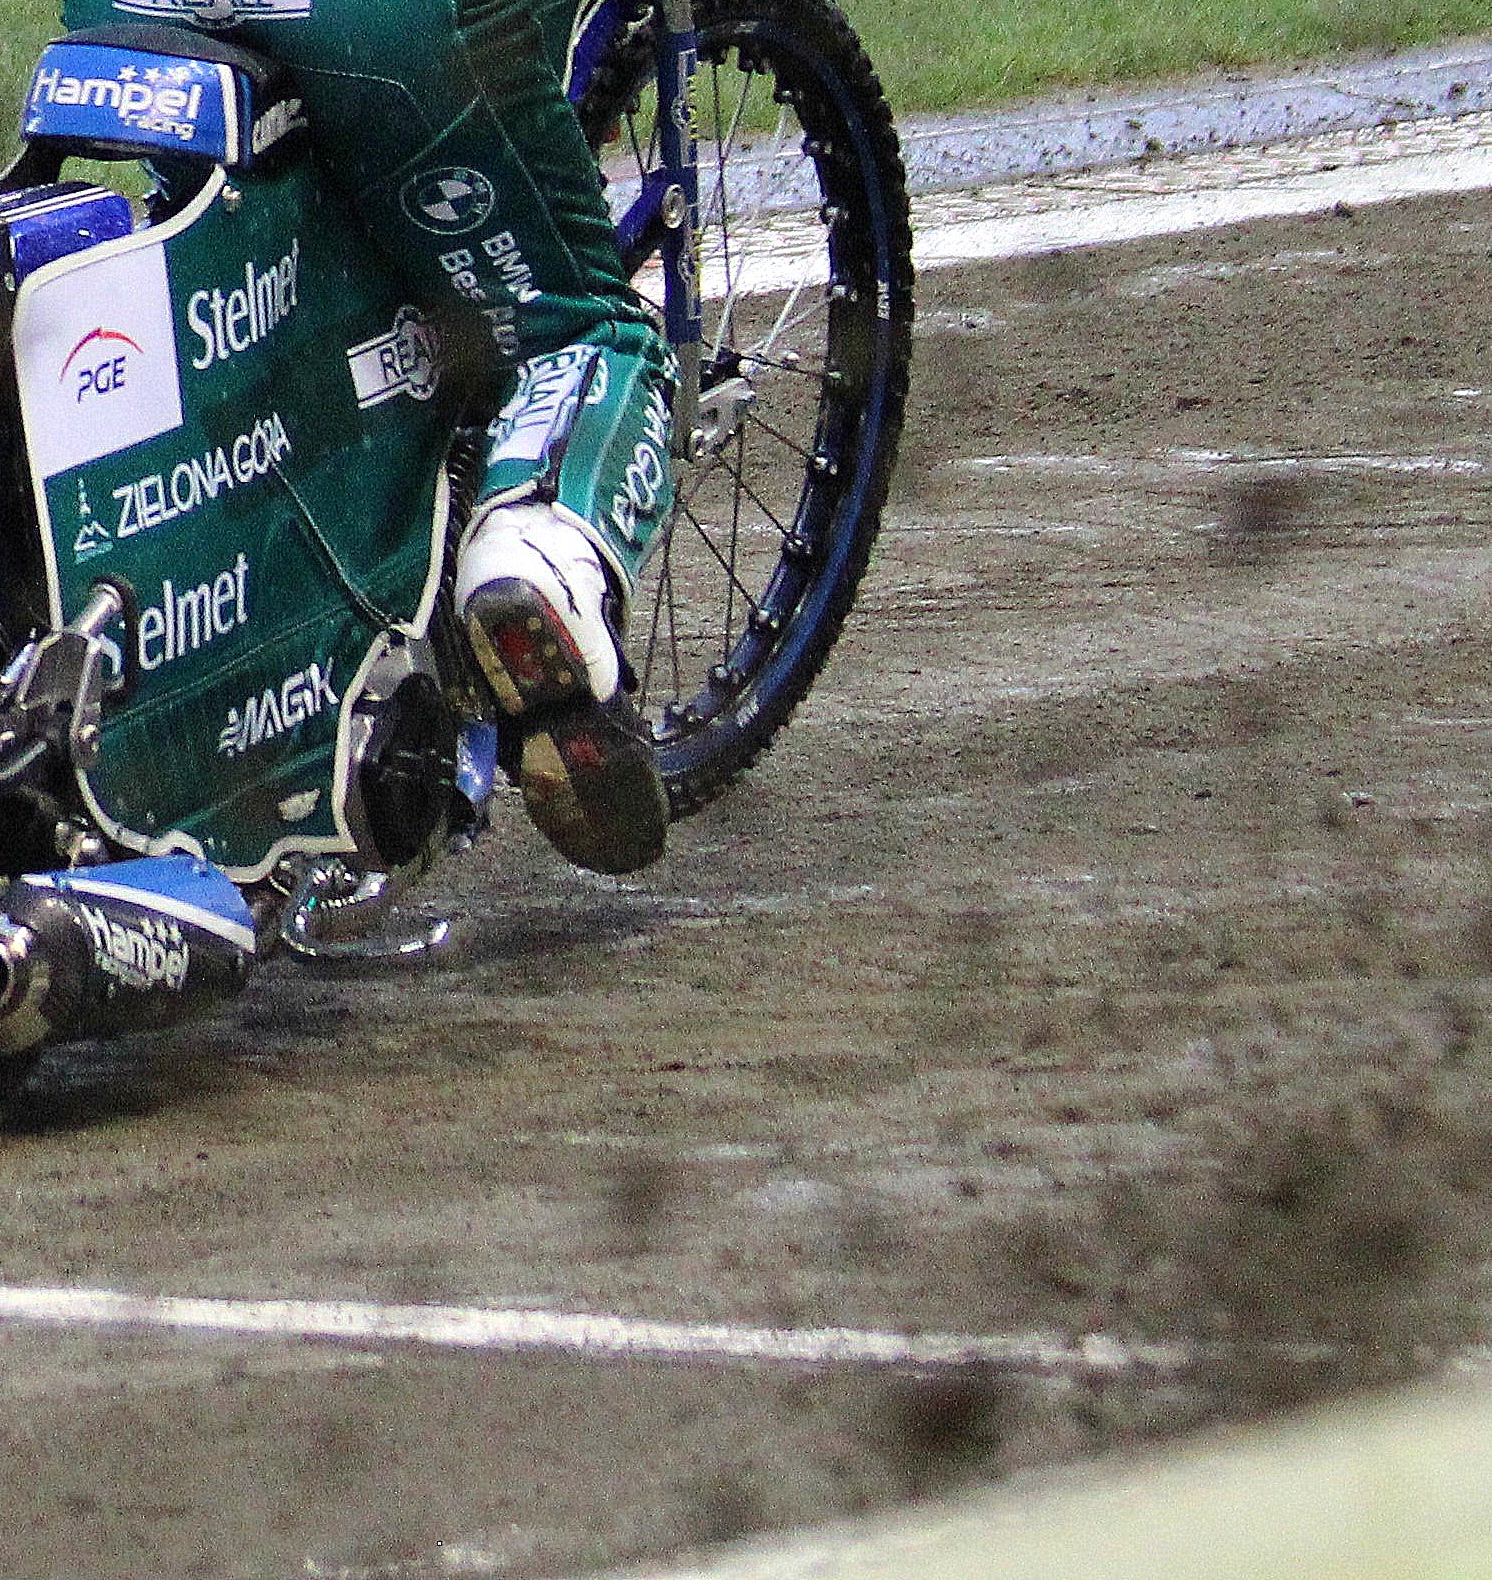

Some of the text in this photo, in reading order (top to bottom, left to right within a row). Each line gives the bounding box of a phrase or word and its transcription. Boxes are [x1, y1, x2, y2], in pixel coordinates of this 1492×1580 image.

[33, 68, 204, 122] Hampel
[186, 238, 301, 372] Stelmet
[480, 229, 544, 305] BMW
[76, 356, 128, 405] PGE
[112, 442, 234, 540] ZIELONA
